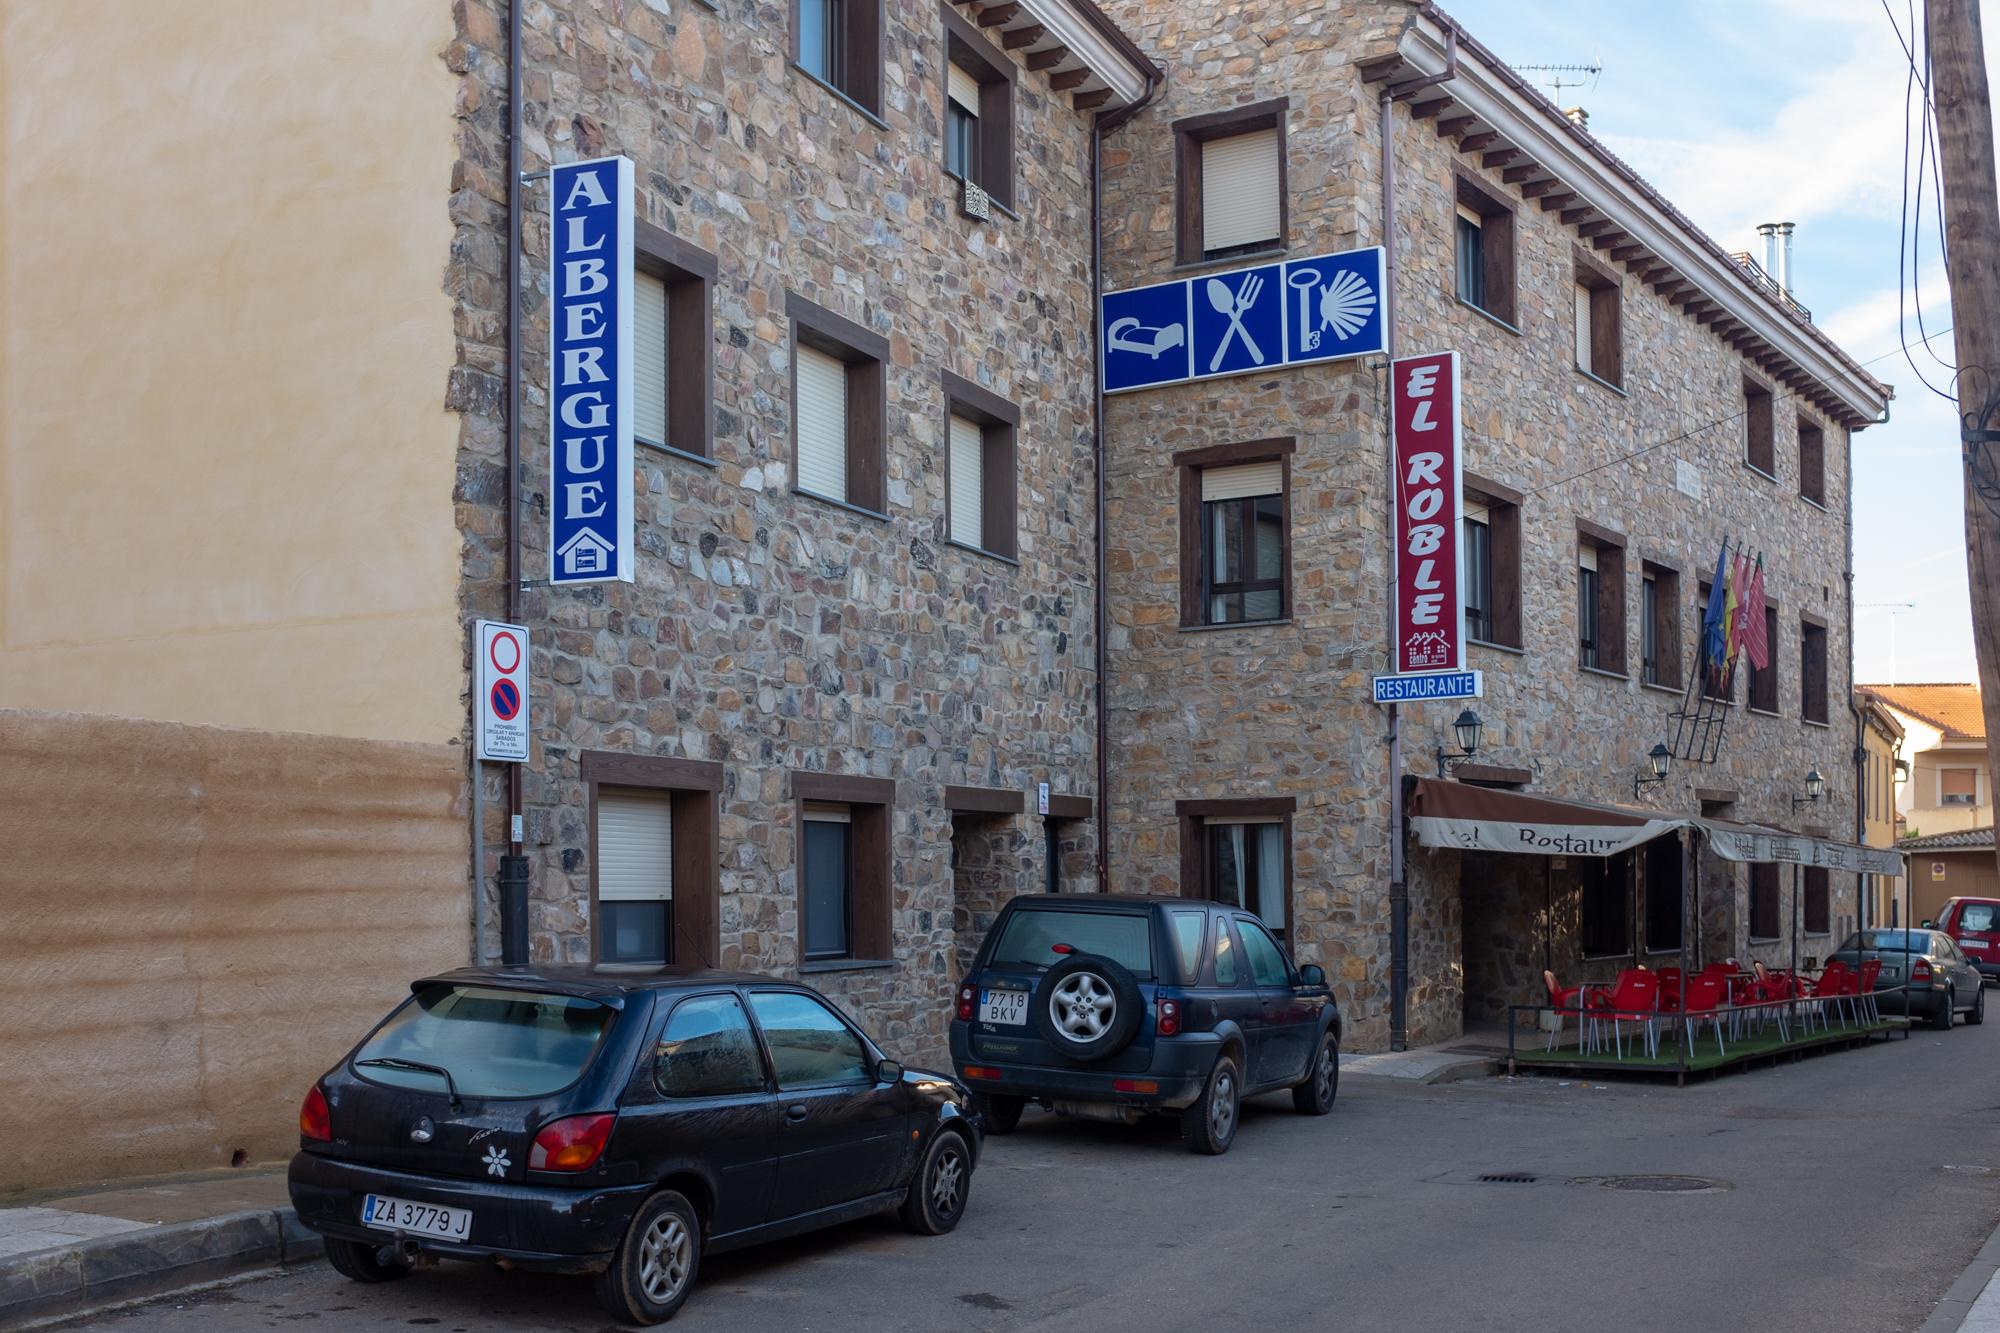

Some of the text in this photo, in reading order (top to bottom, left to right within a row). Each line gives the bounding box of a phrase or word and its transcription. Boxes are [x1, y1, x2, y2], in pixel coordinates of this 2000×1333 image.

[560, 170, 612, 520] ALBERGUE
[1406, 364, 1446, 625] EL ROBLE
[1377, 676, 1473, 698] RESTAURANTE
[989, 993, 1025, 1007] 7718
[991, 1007, 1017, 1021] BKV
[374, 1200, 396, 1223] ZA
[402, 1204, 450, 1232] 3779
[455, 1213, 467, 1235] J
